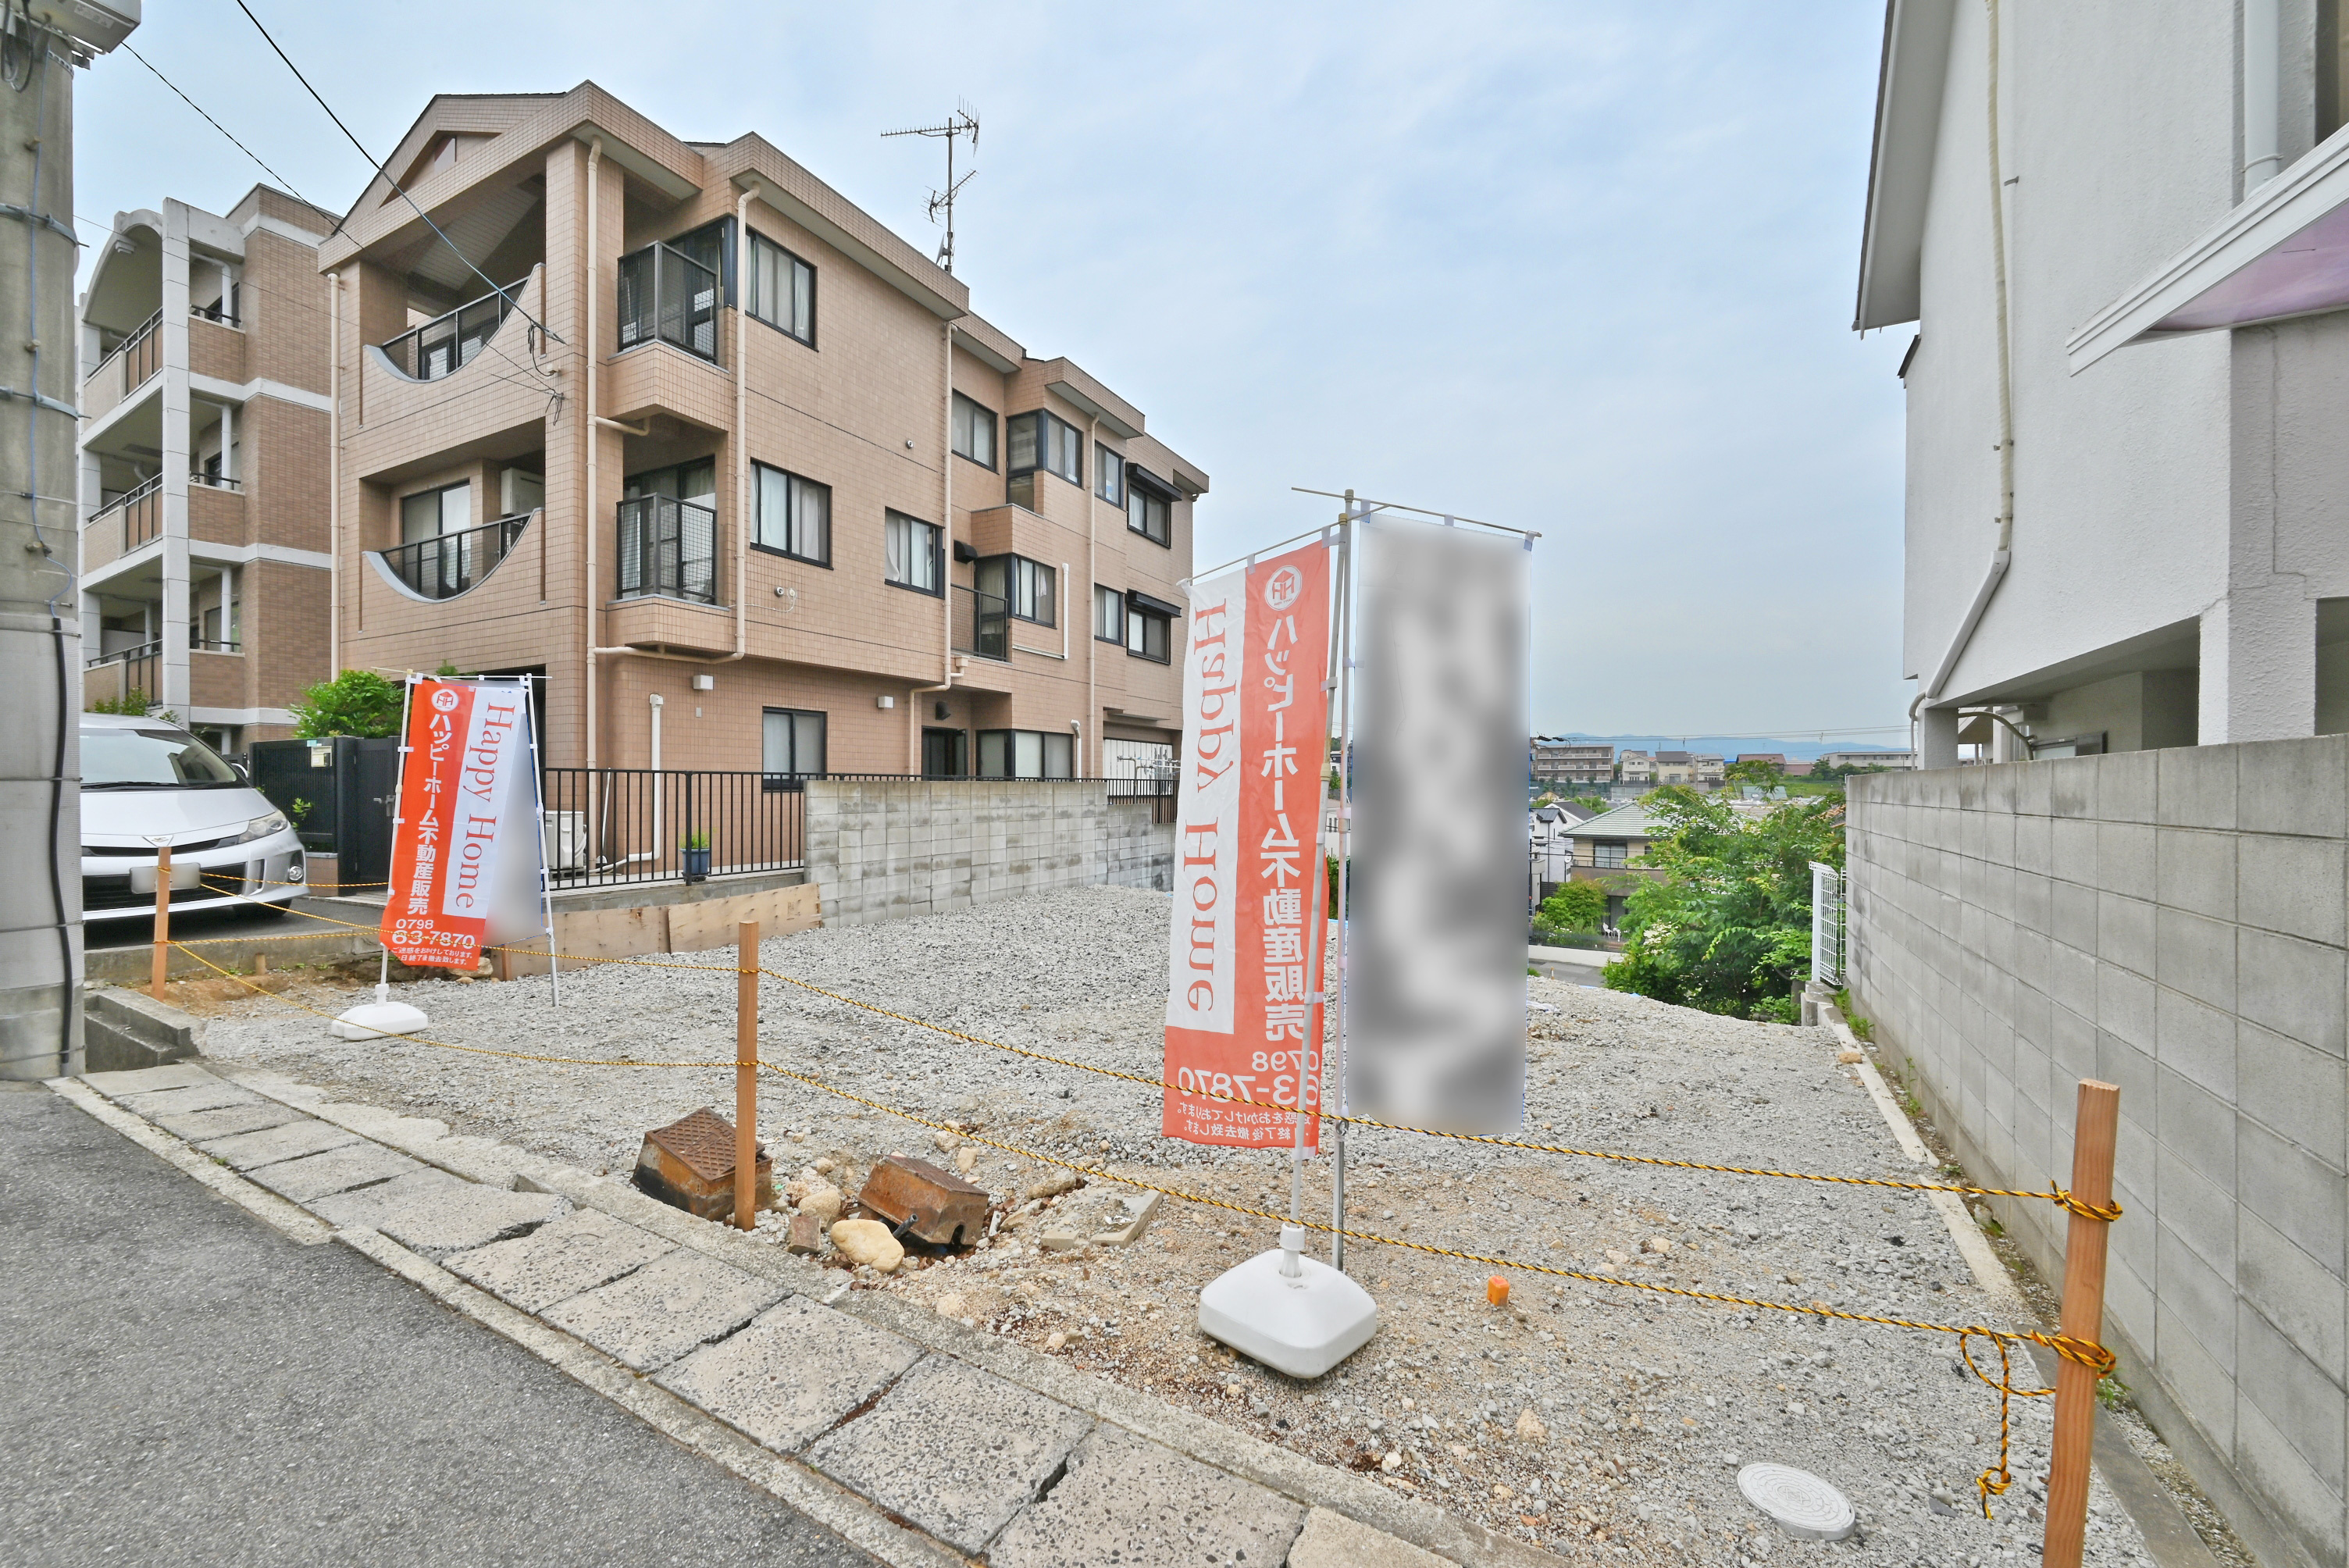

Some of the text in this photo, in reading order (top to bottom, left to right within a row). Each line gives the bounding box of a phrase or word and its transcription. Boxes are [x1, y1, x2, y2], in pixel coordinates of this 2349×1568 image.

[407, 713, 453, 915] ハッピーホーム不動産販売
[456, 702, 515, 909] Happy Home
[396, 918, 434, 929] 0798
